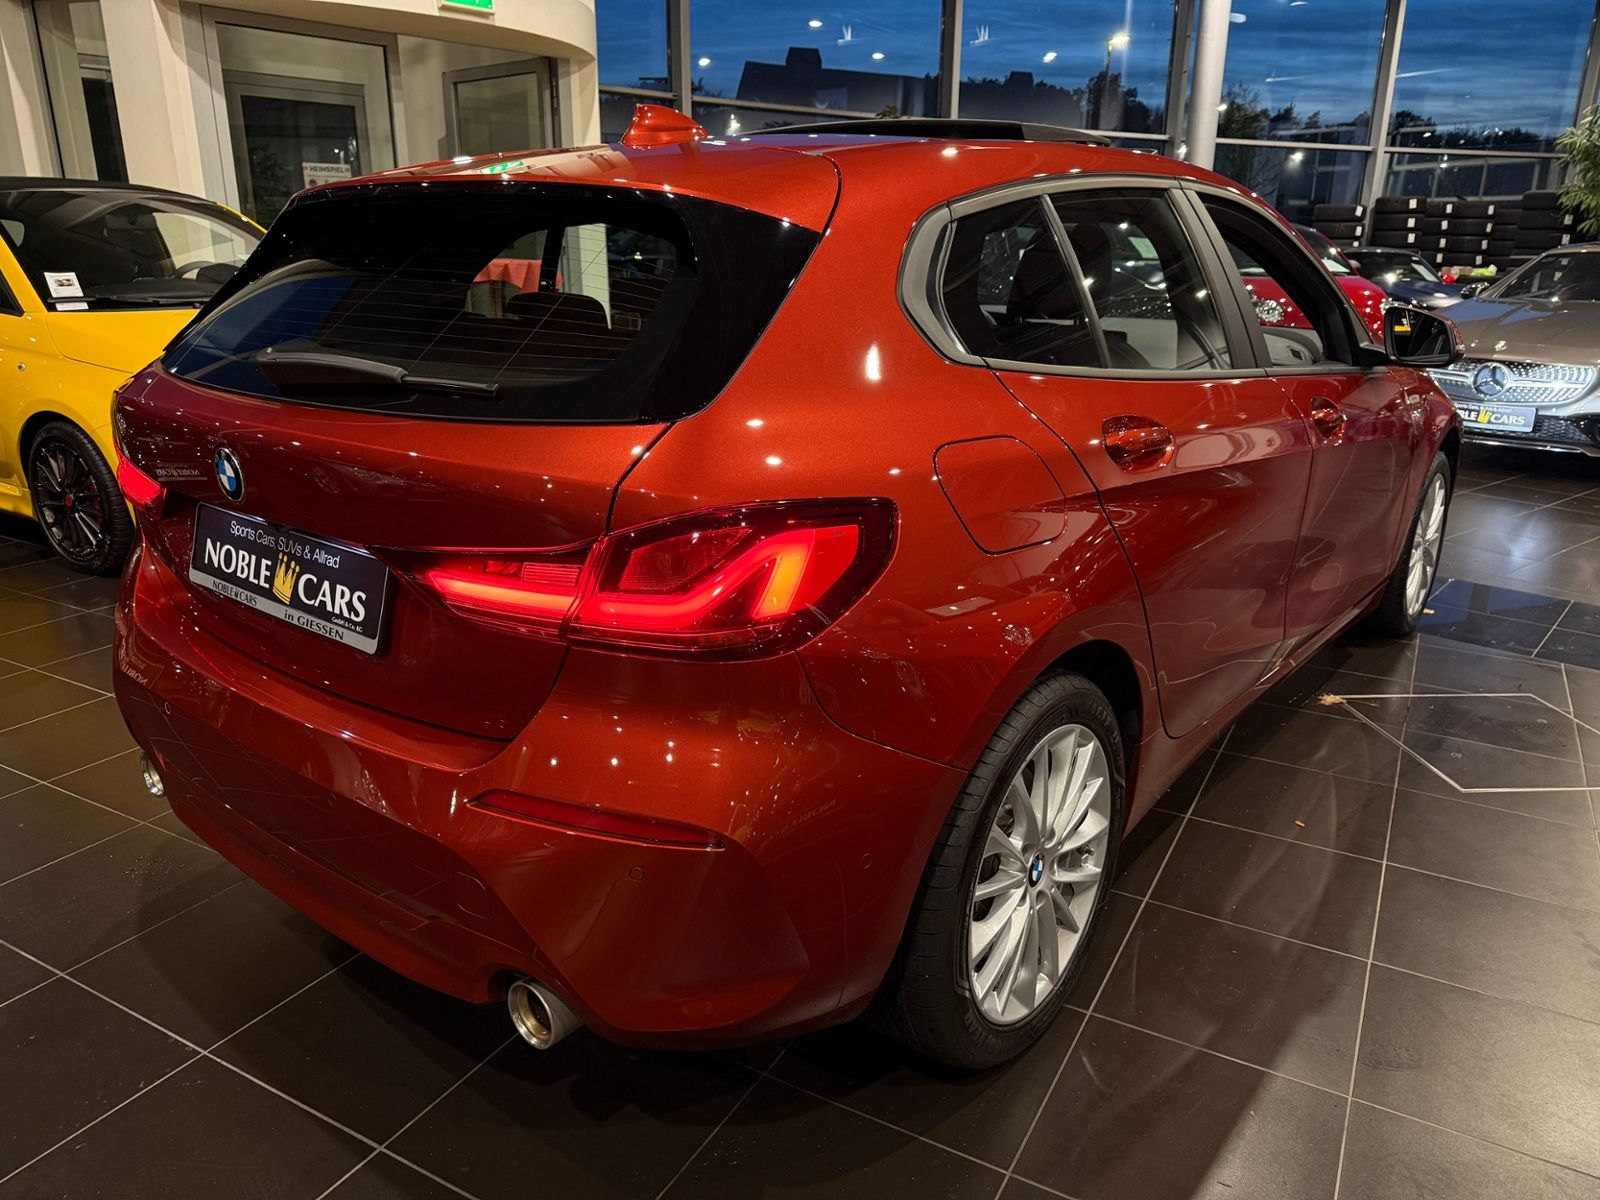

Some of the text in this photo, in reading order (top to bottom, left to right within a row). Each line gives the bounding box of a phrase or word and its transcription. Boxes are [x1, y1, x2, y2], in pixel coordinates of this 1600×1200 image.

[309, 166, 344, 174] HEIMSPIEL
[1456, 409, 1525, 425] BLE CARS
[230, 520, 340, 569] Sports Cars, SUVs & Allrad
[204, 537, 367, 622] NOBLE CARS
[212, 580, 257, 606] NOBLE CARS
[284, 610, 344, 640] in GIESSEN
